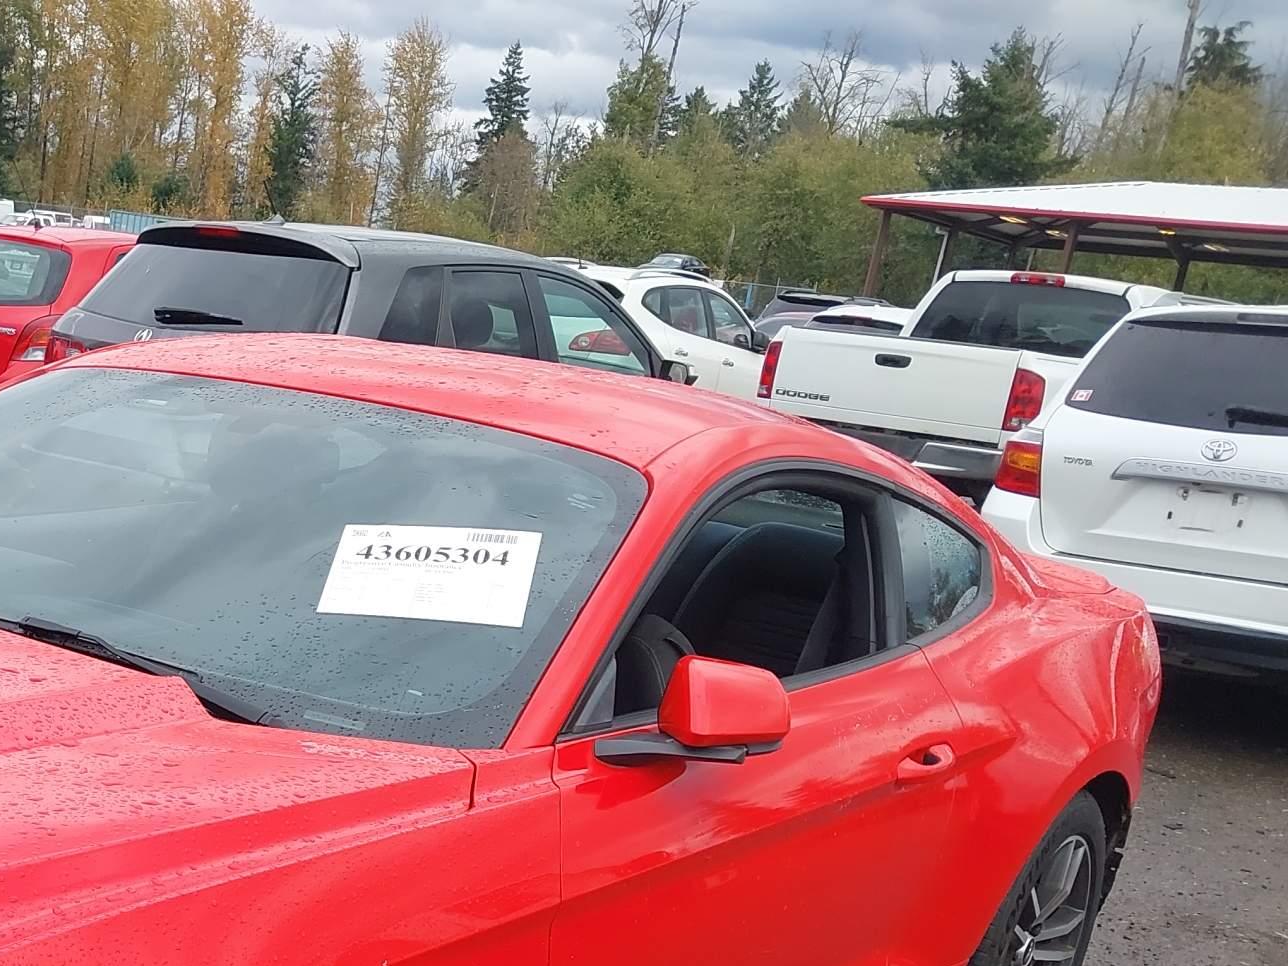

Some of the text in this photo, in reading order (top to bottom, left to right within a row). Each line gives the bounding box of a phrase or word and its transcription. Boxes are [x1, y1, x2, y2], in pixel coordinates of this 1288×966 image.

[775, 388, 830, 401] DODGE
[1063, 456, 1092, 466] TOYOTA
[1135, 461, 1285, 487] HIGHLANDER
[355, 544, 510, 566] 43605304
